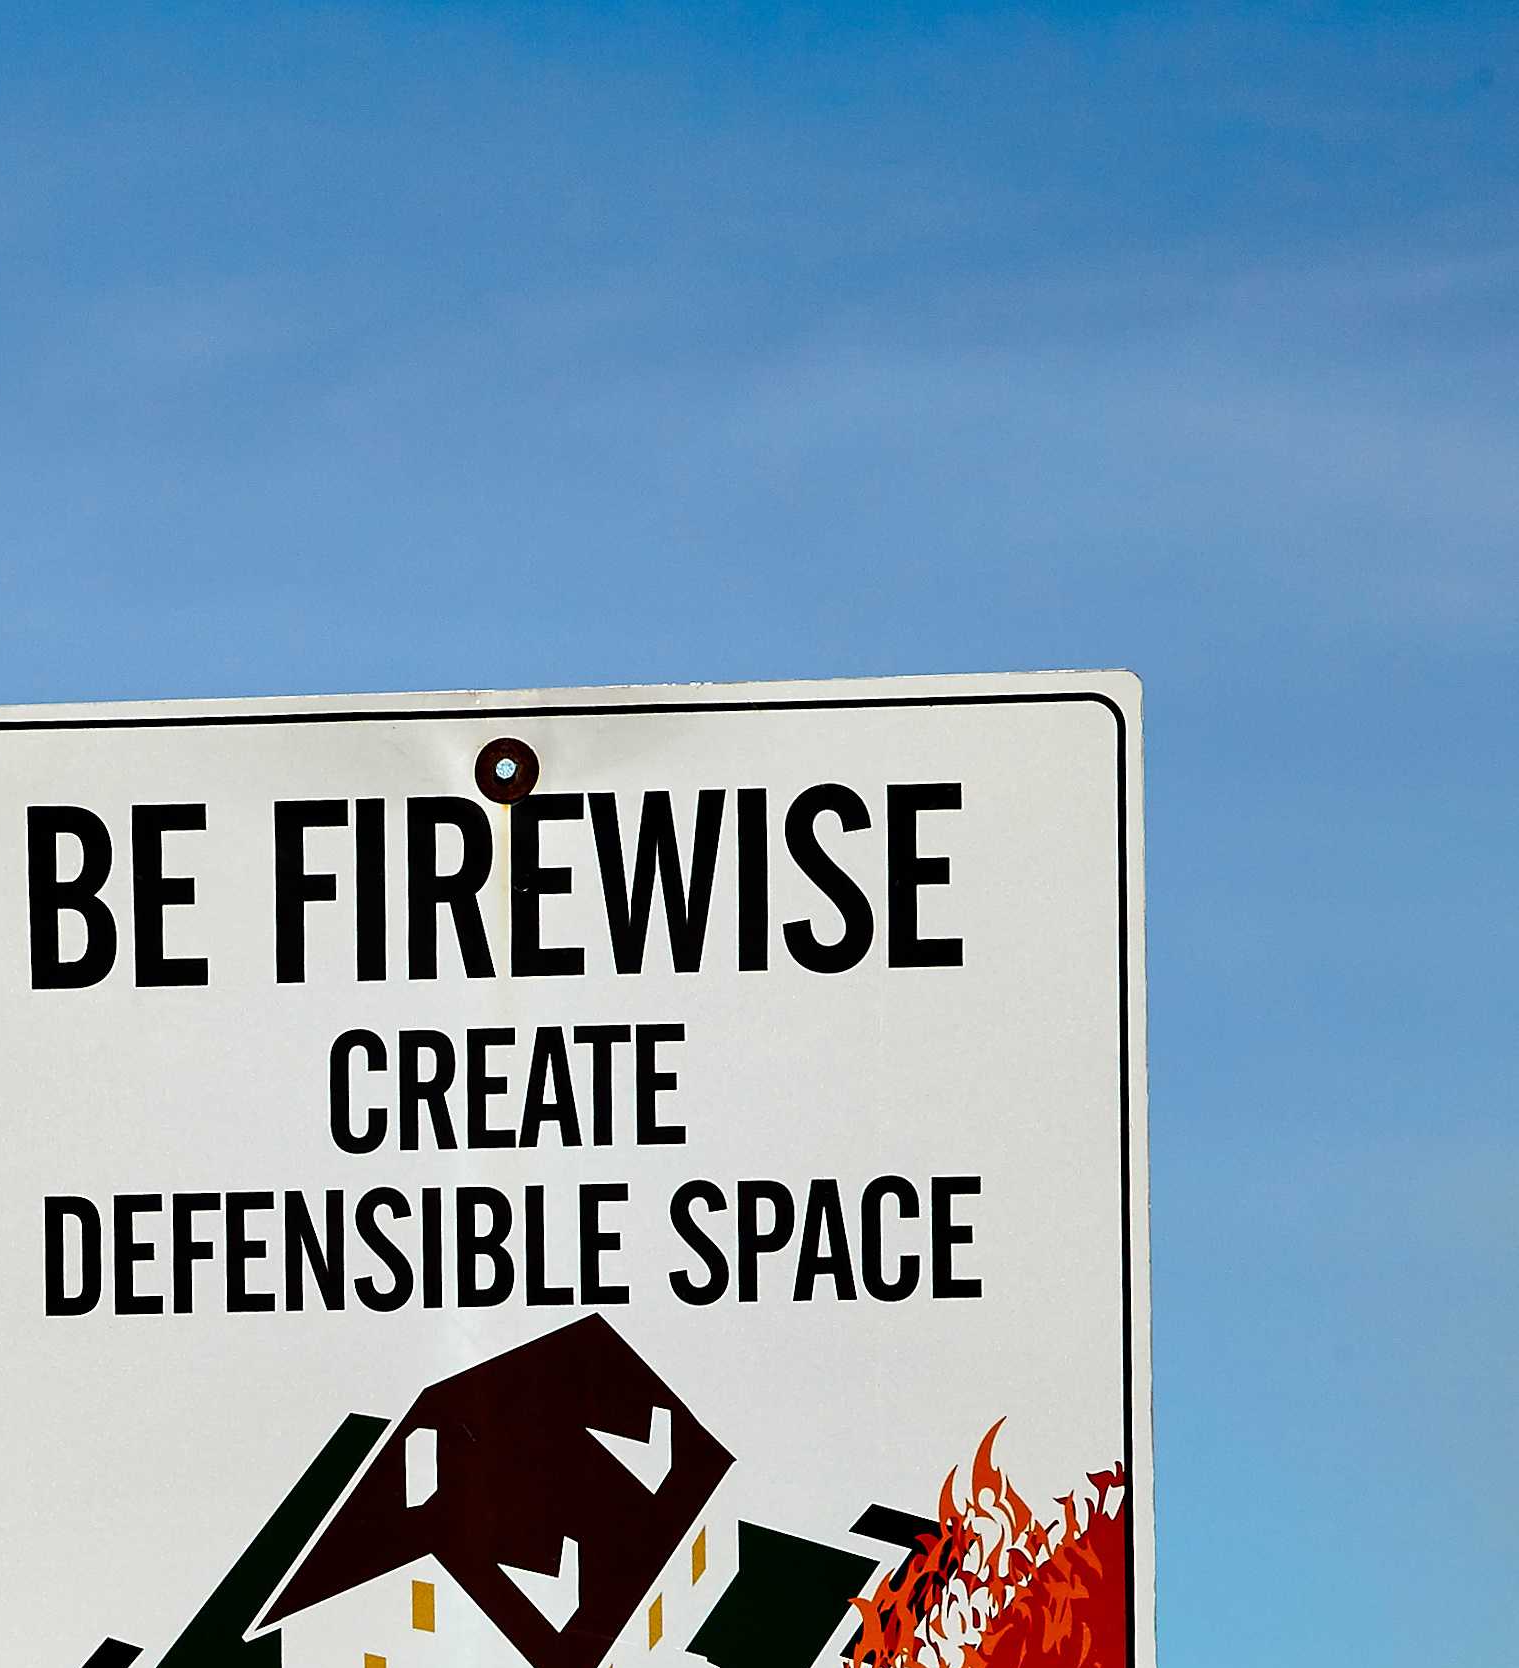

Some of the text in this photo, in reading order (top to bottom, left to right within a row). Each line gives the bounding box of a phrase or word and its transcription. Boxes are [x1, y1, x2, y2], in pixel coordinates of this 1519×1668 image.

[26, 782, 964, 990] BE FIREWISE
[329, 1023, 687, 1155] CREATE
[44, 1175, 983, 1317] DEFENSIBLE SPACE
